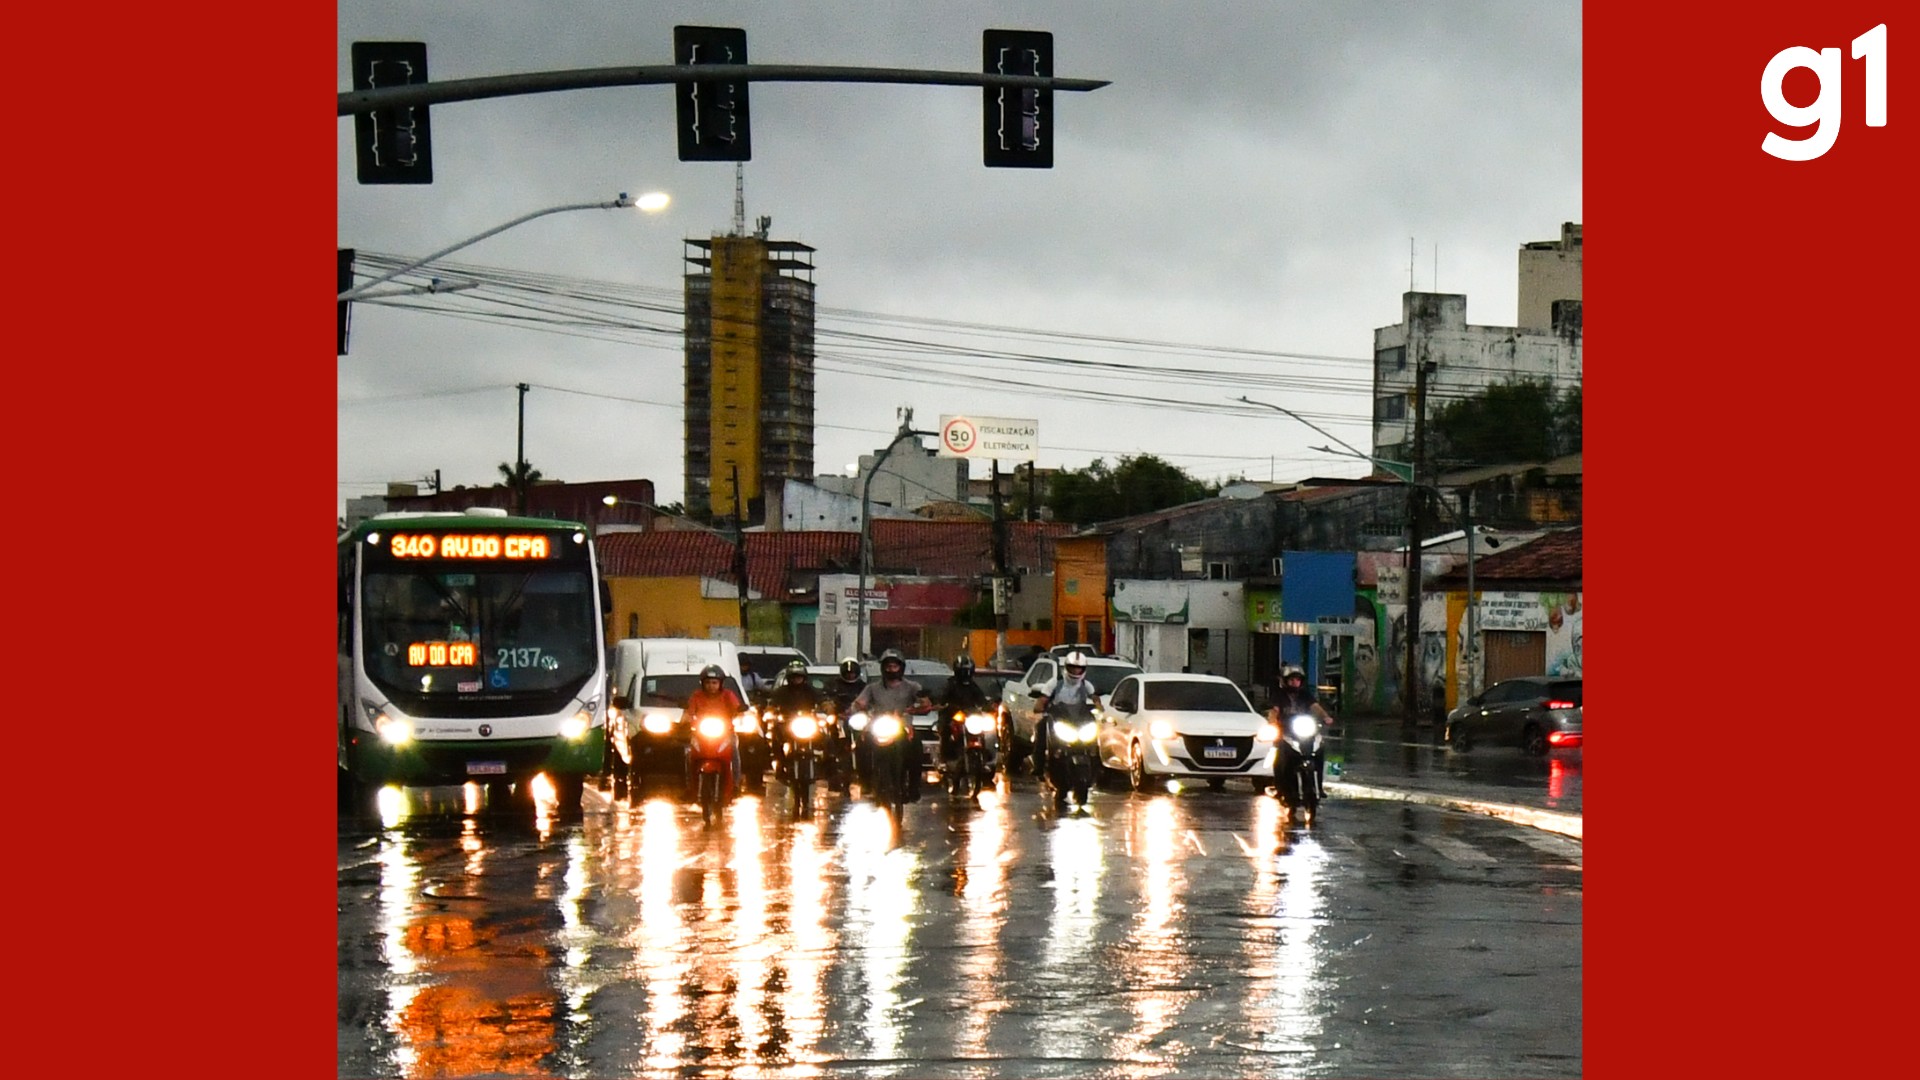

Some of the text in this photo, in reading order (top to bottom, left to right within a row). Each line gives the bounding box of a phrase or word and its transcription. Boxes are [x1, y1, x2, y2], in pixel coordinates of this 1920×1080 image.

[950, 430, 970, 442] 50
[980, 426, 1035, 436] FISCALIZAÇÃO
[983, 441, 1030, 451] ELETRÔNICA
[391, 535, 436, 558] 340
[504, 535, 546, 558] CPA
[408, 643, 475, 667] AV DO CPA
[497, 648, 541, 668] 2137
